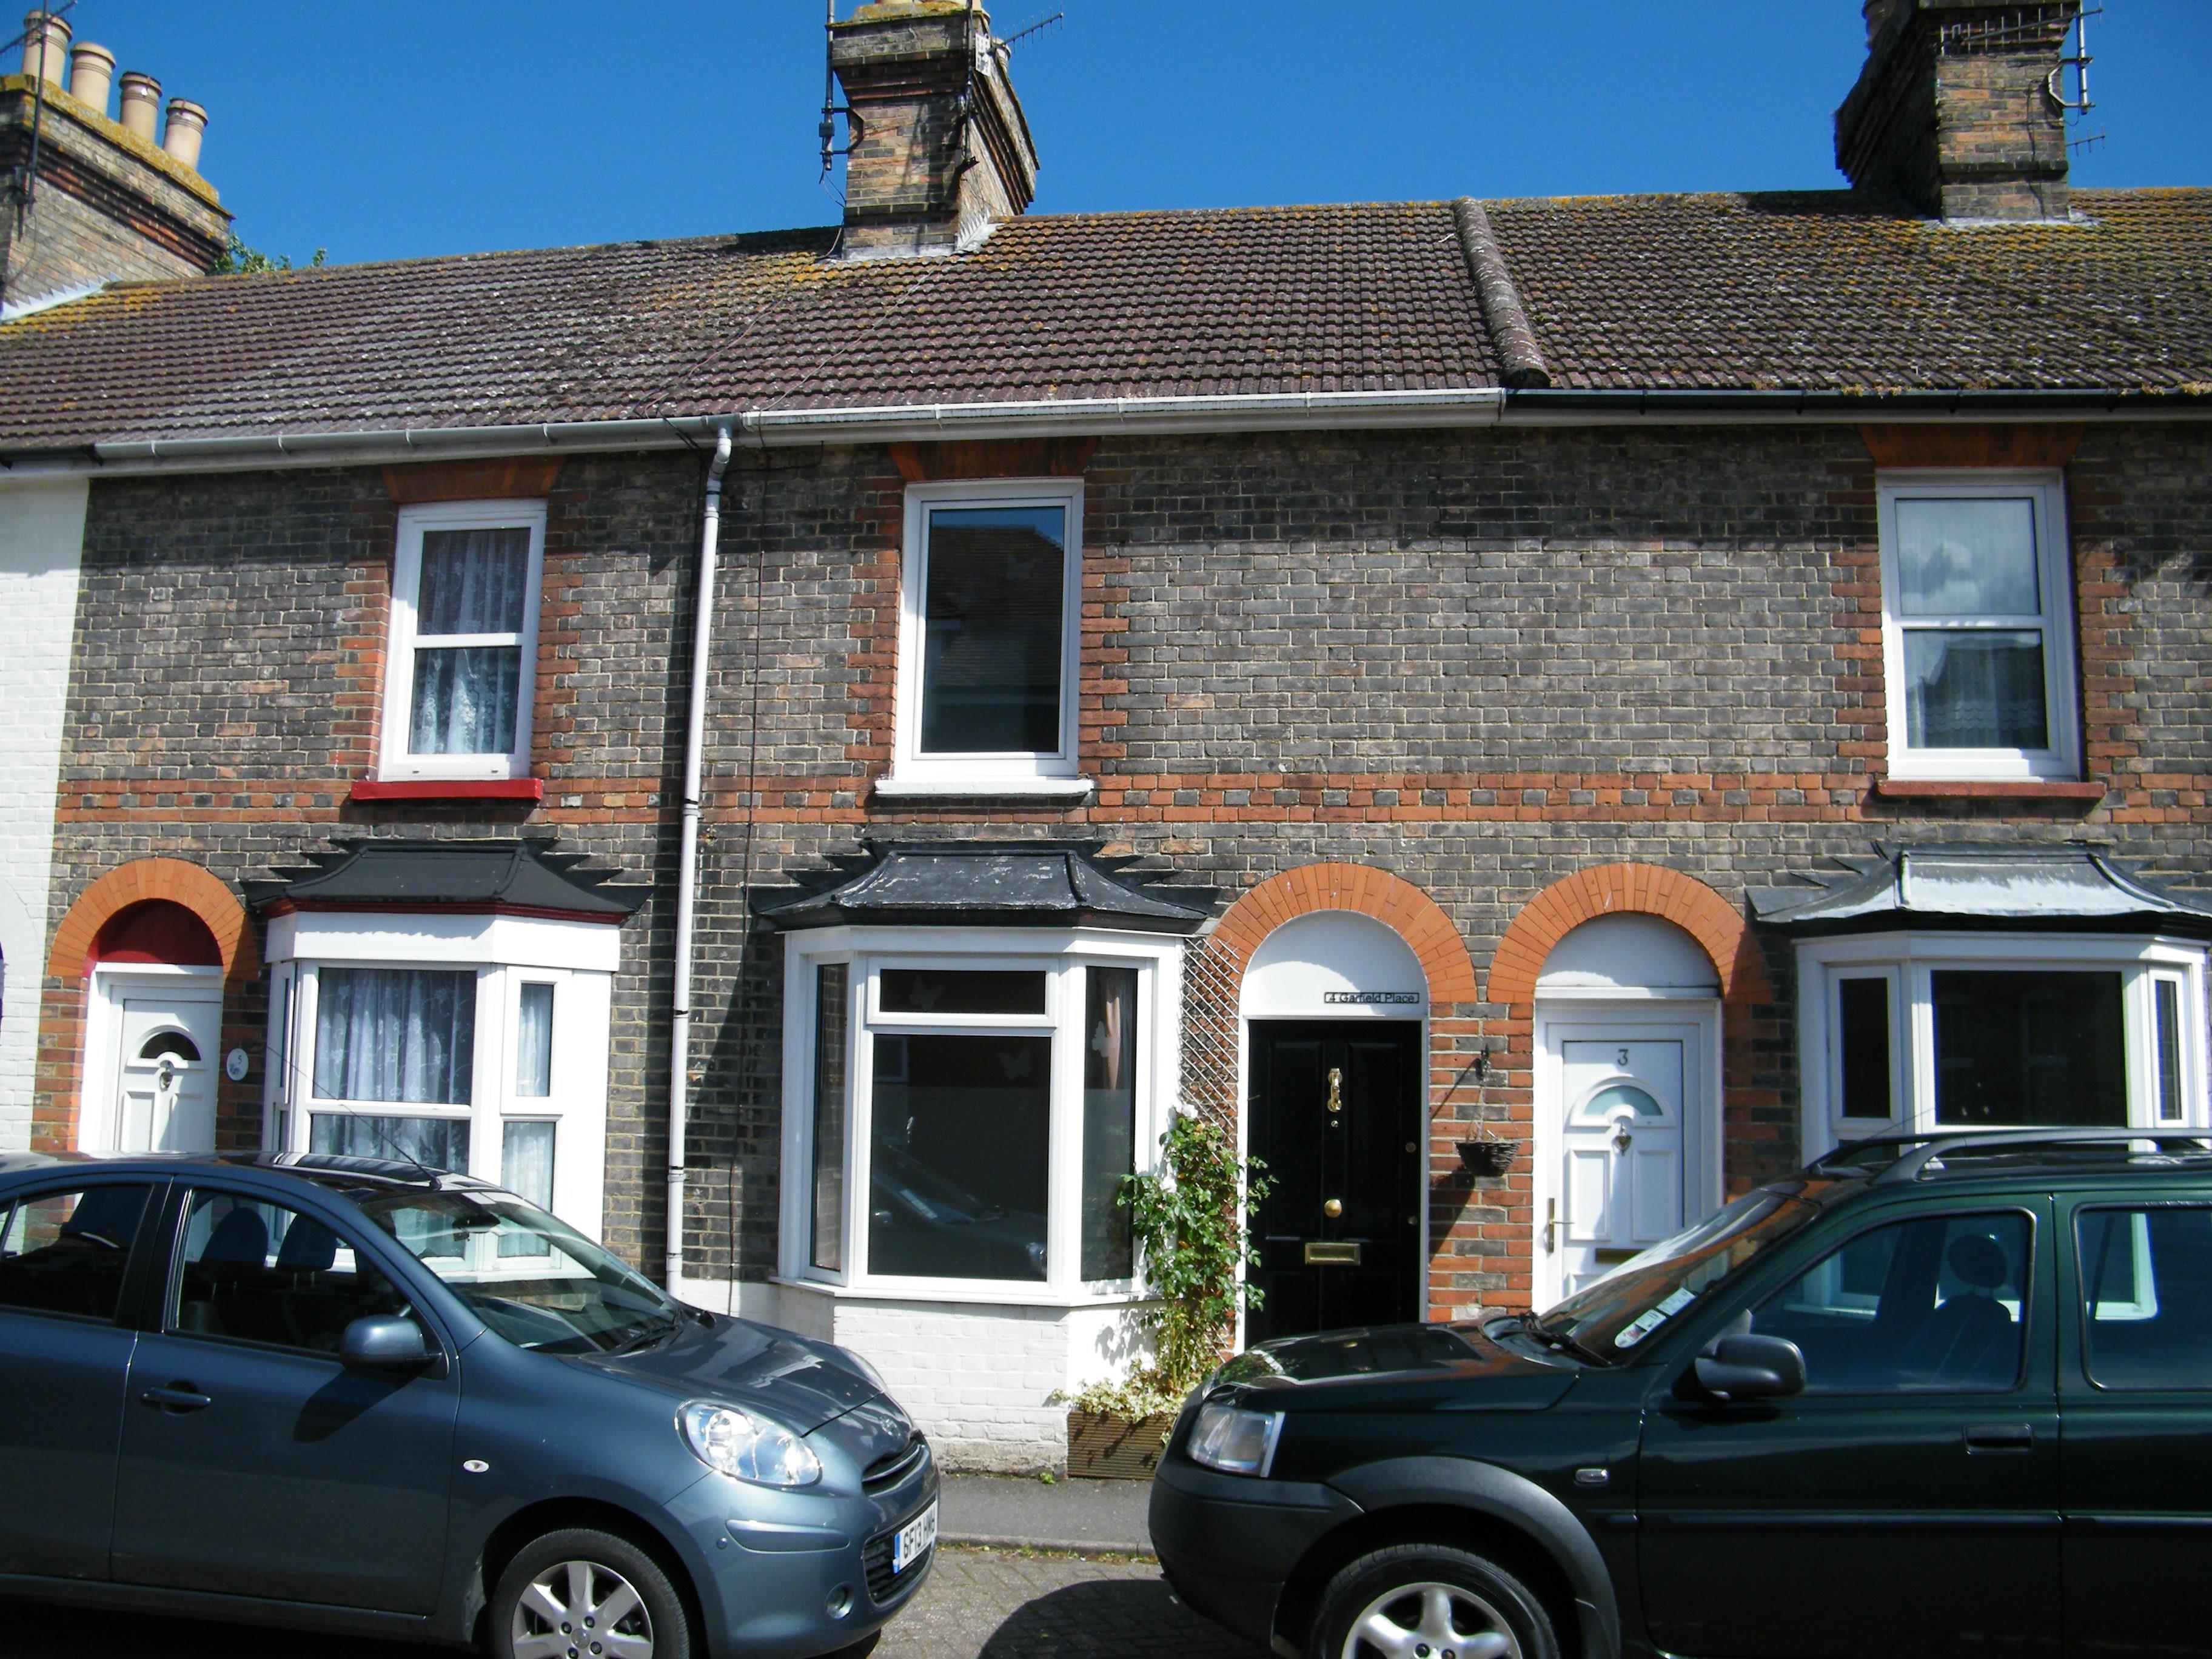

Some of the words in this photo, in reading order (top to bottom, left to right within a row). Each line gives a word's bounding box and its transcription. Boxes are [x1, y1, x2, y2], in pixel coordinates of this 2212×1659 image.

[1329, 993, 1336, 1003] 4
[1339, 992, 1381, 1003] Garfield
[1385, 992, 1415, 1004] Place
[238, 1055, 242, 1064] 5
[1617, 1048, 1628, 1066] 3
